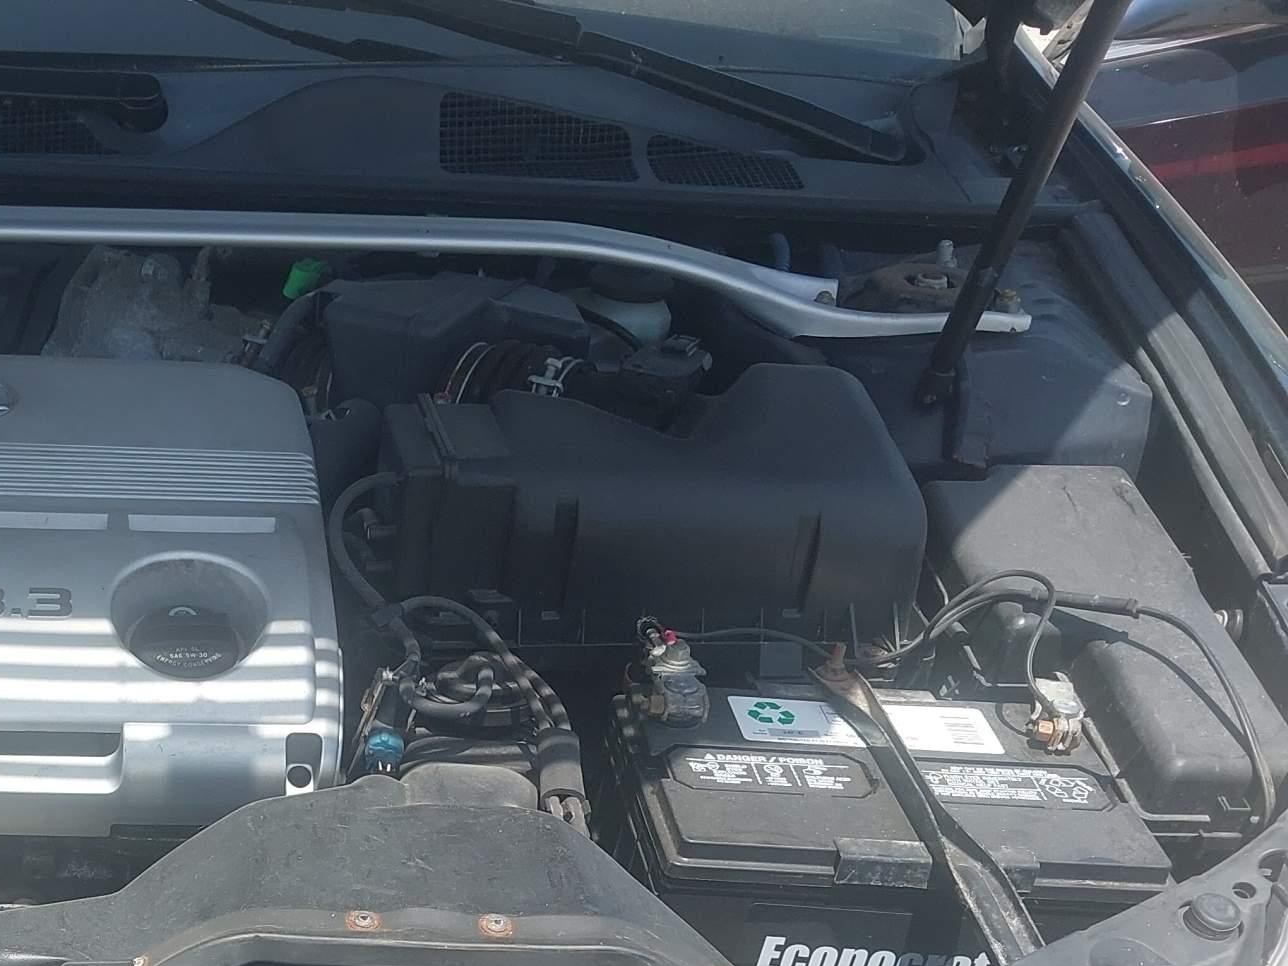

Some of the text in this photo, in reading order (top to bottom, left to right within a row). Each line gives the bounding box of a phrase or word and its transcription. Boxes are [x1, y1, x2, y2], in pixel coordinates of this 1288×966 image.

[169, 652, 184, 660] SAE
[716, 753, 767, 763] DANGER
[779, 756, 824, 766] POISON
